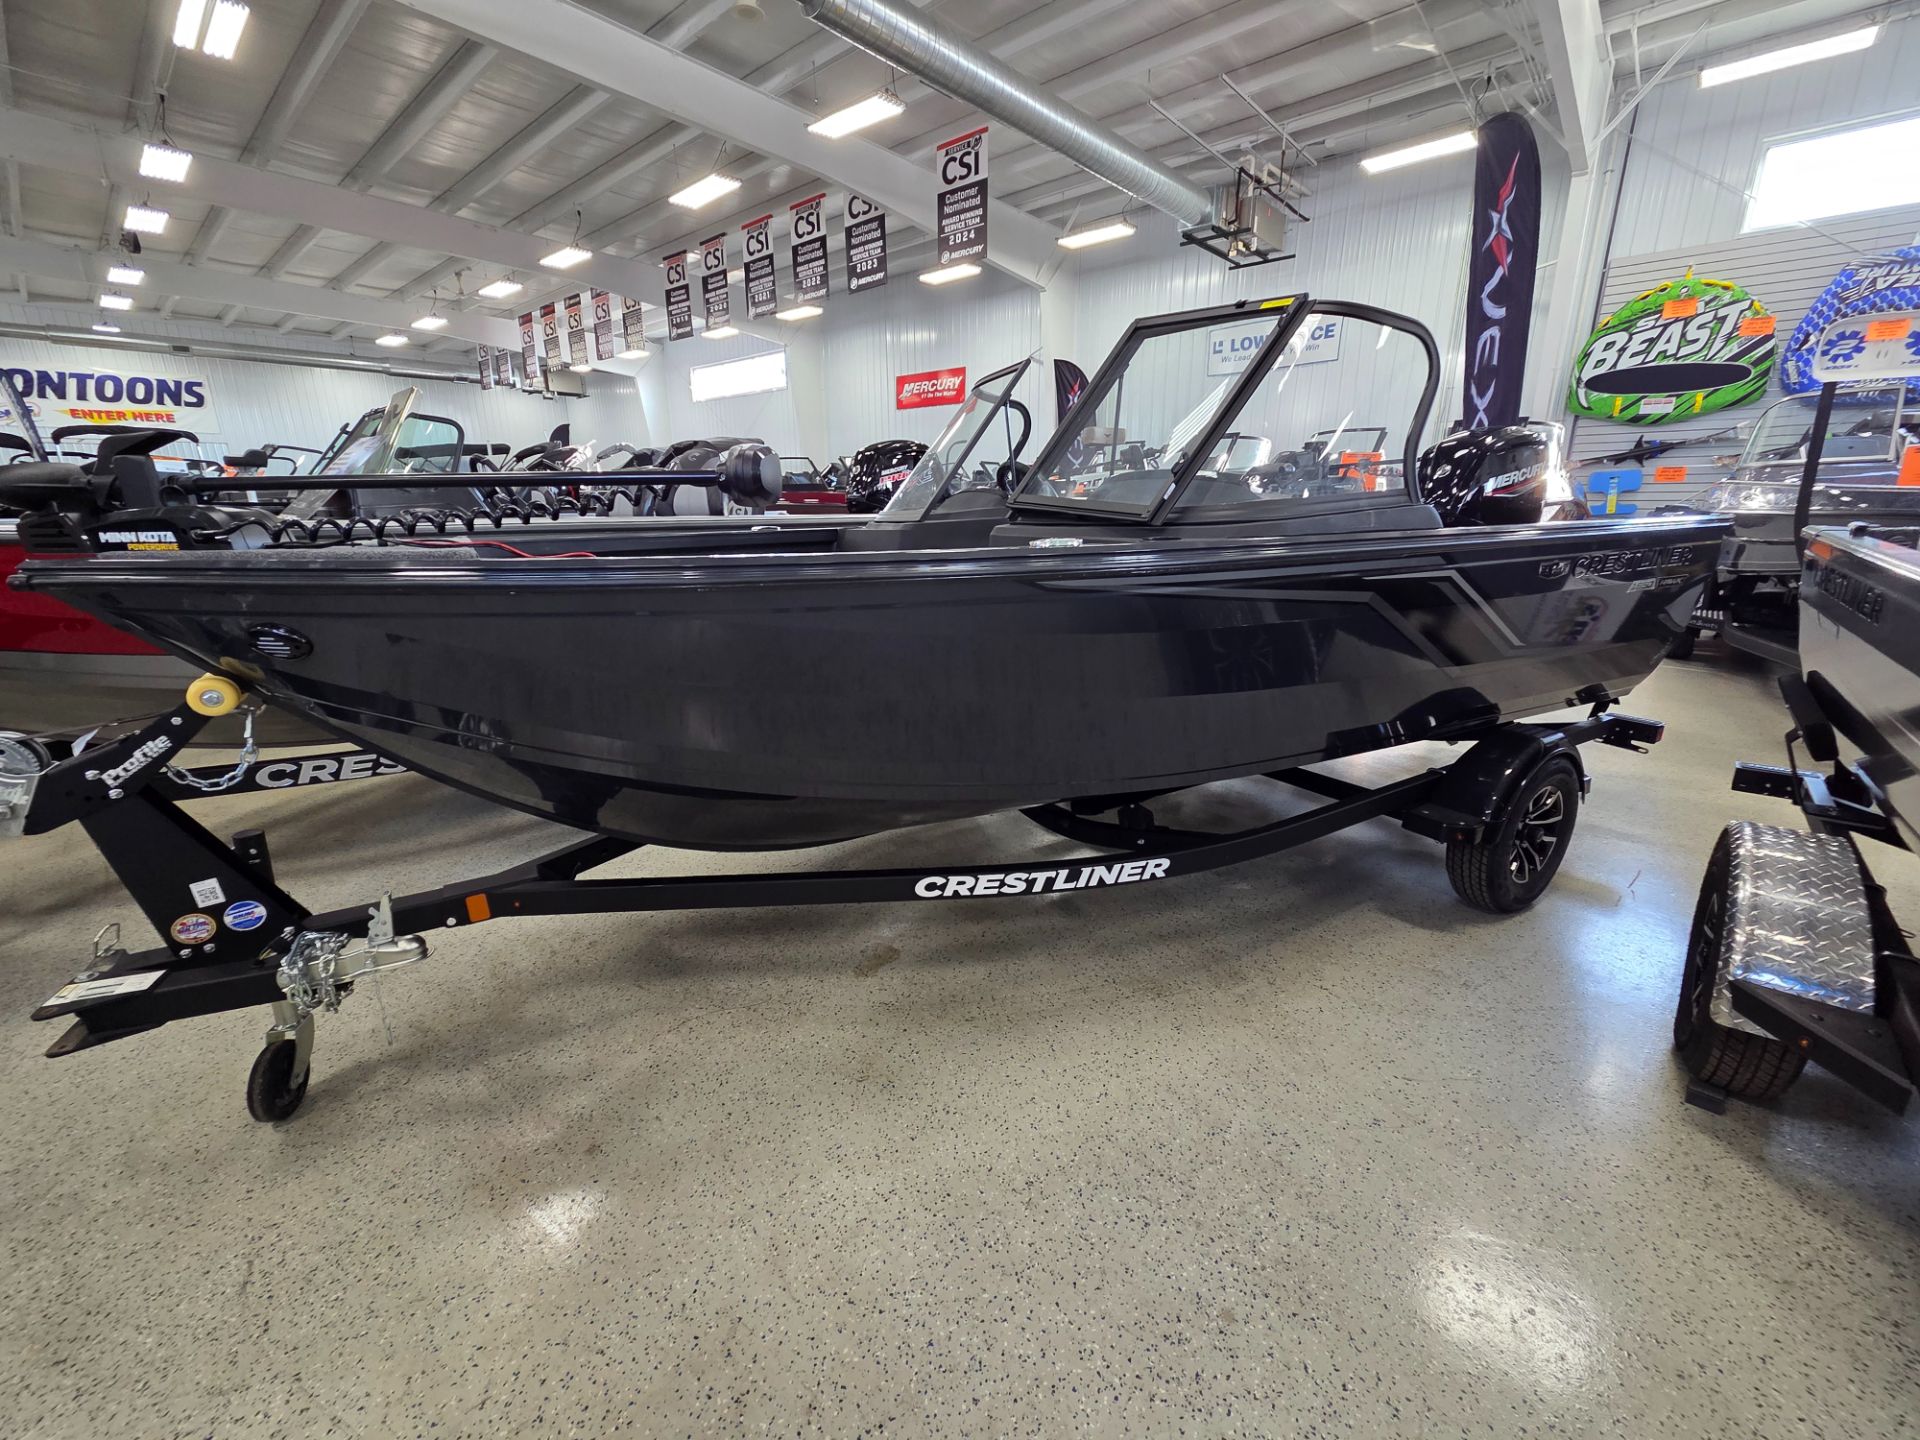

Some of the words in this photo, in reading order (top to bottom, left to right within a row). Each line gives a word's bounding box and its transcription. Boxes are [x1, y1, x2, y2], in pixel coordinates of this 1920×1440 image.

[941, 150, 980, 185] CSI
[945, 186, 979, 204] Customer
[943, 195, 981, 215] Nominated
[794, 210, 821, 239] CSI
[941, 214, 960, 226] AWARD
[960, 207, 983, 220] WINNING
[944, 221, 966, 233] SERVICE
[966, 216, 981, 227] TEAM
[851, 228, 881, 246] Nominated
[852, 221, 879, 236] Customer
[948, 229, 976, 246] 2024
[746, 230, 770, 257] CSI
[950, 244, 984, 259] MERCURY
[704, 247, 725, 271] CSI
[856, 258, 878, 273] 2023
[667, 263, 686, 285] CSI
[802, 275, 821, 289] 2022
[858, 271, 885, 286] MERCURY
[754, 290, 770, 302] 2021
[595, 302, 611, 321] CSI
[543, 321, 557, 338] CSI
[567, 313, 582, 330] CSI
[522, 329, 535, 345] CSI
[1580, 299, 1753, 382] BEAST
[1305, 343, 1320, 352] Win
[898, 376, 963, 401] MERCURY
[68, 408, 129, 422] ENTER
[131, 411, 177, 423] HERE
[137, 531, 177, 542] KOTA
[1572, 546, 1694, 578] CRESTLINER
[100, 735, 171, 784] Profile
[914, 858, 1171, 898] CRESTLINER
